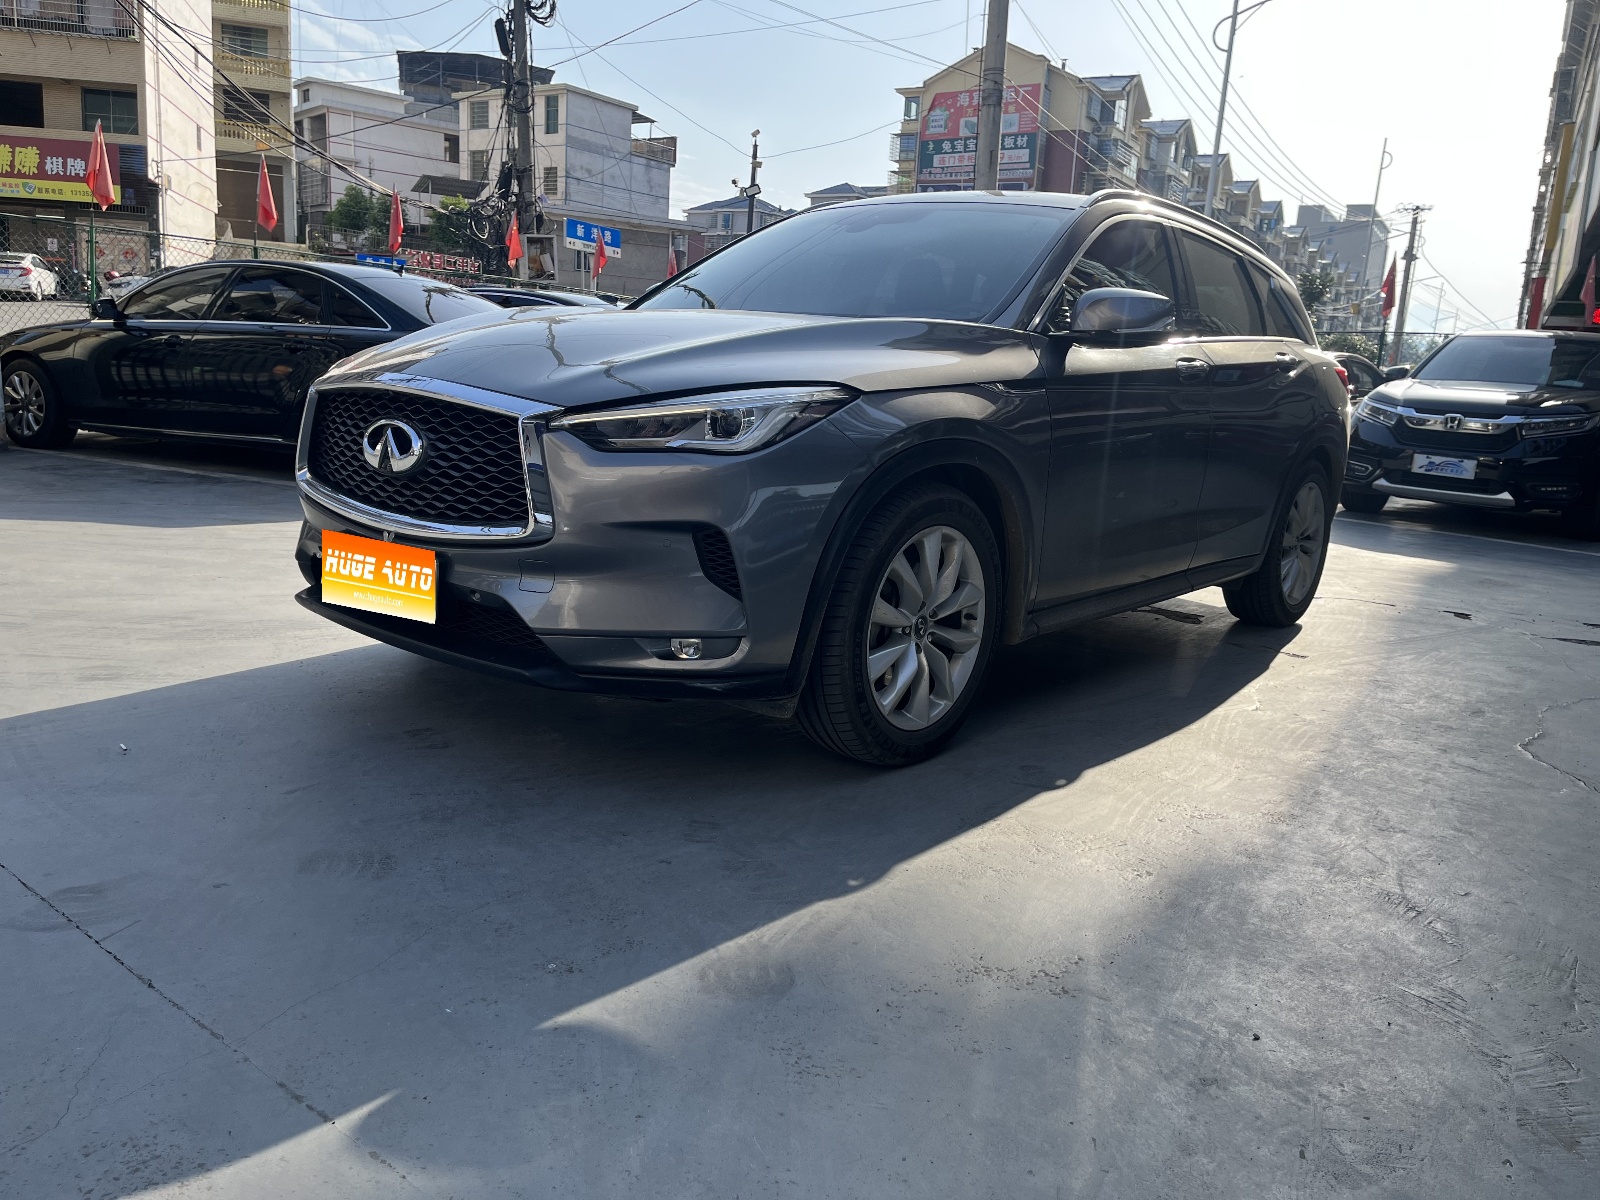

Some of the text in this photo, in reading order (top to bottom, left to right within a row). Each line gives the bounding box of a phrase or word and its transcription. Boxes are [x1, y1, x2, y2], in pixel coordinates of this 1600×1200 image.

[941, 134, 1029, 153] 兔宝宝板材
[45, 156, 87, 177] 棋牌
[576, 223, 612, 244] 新洋路
